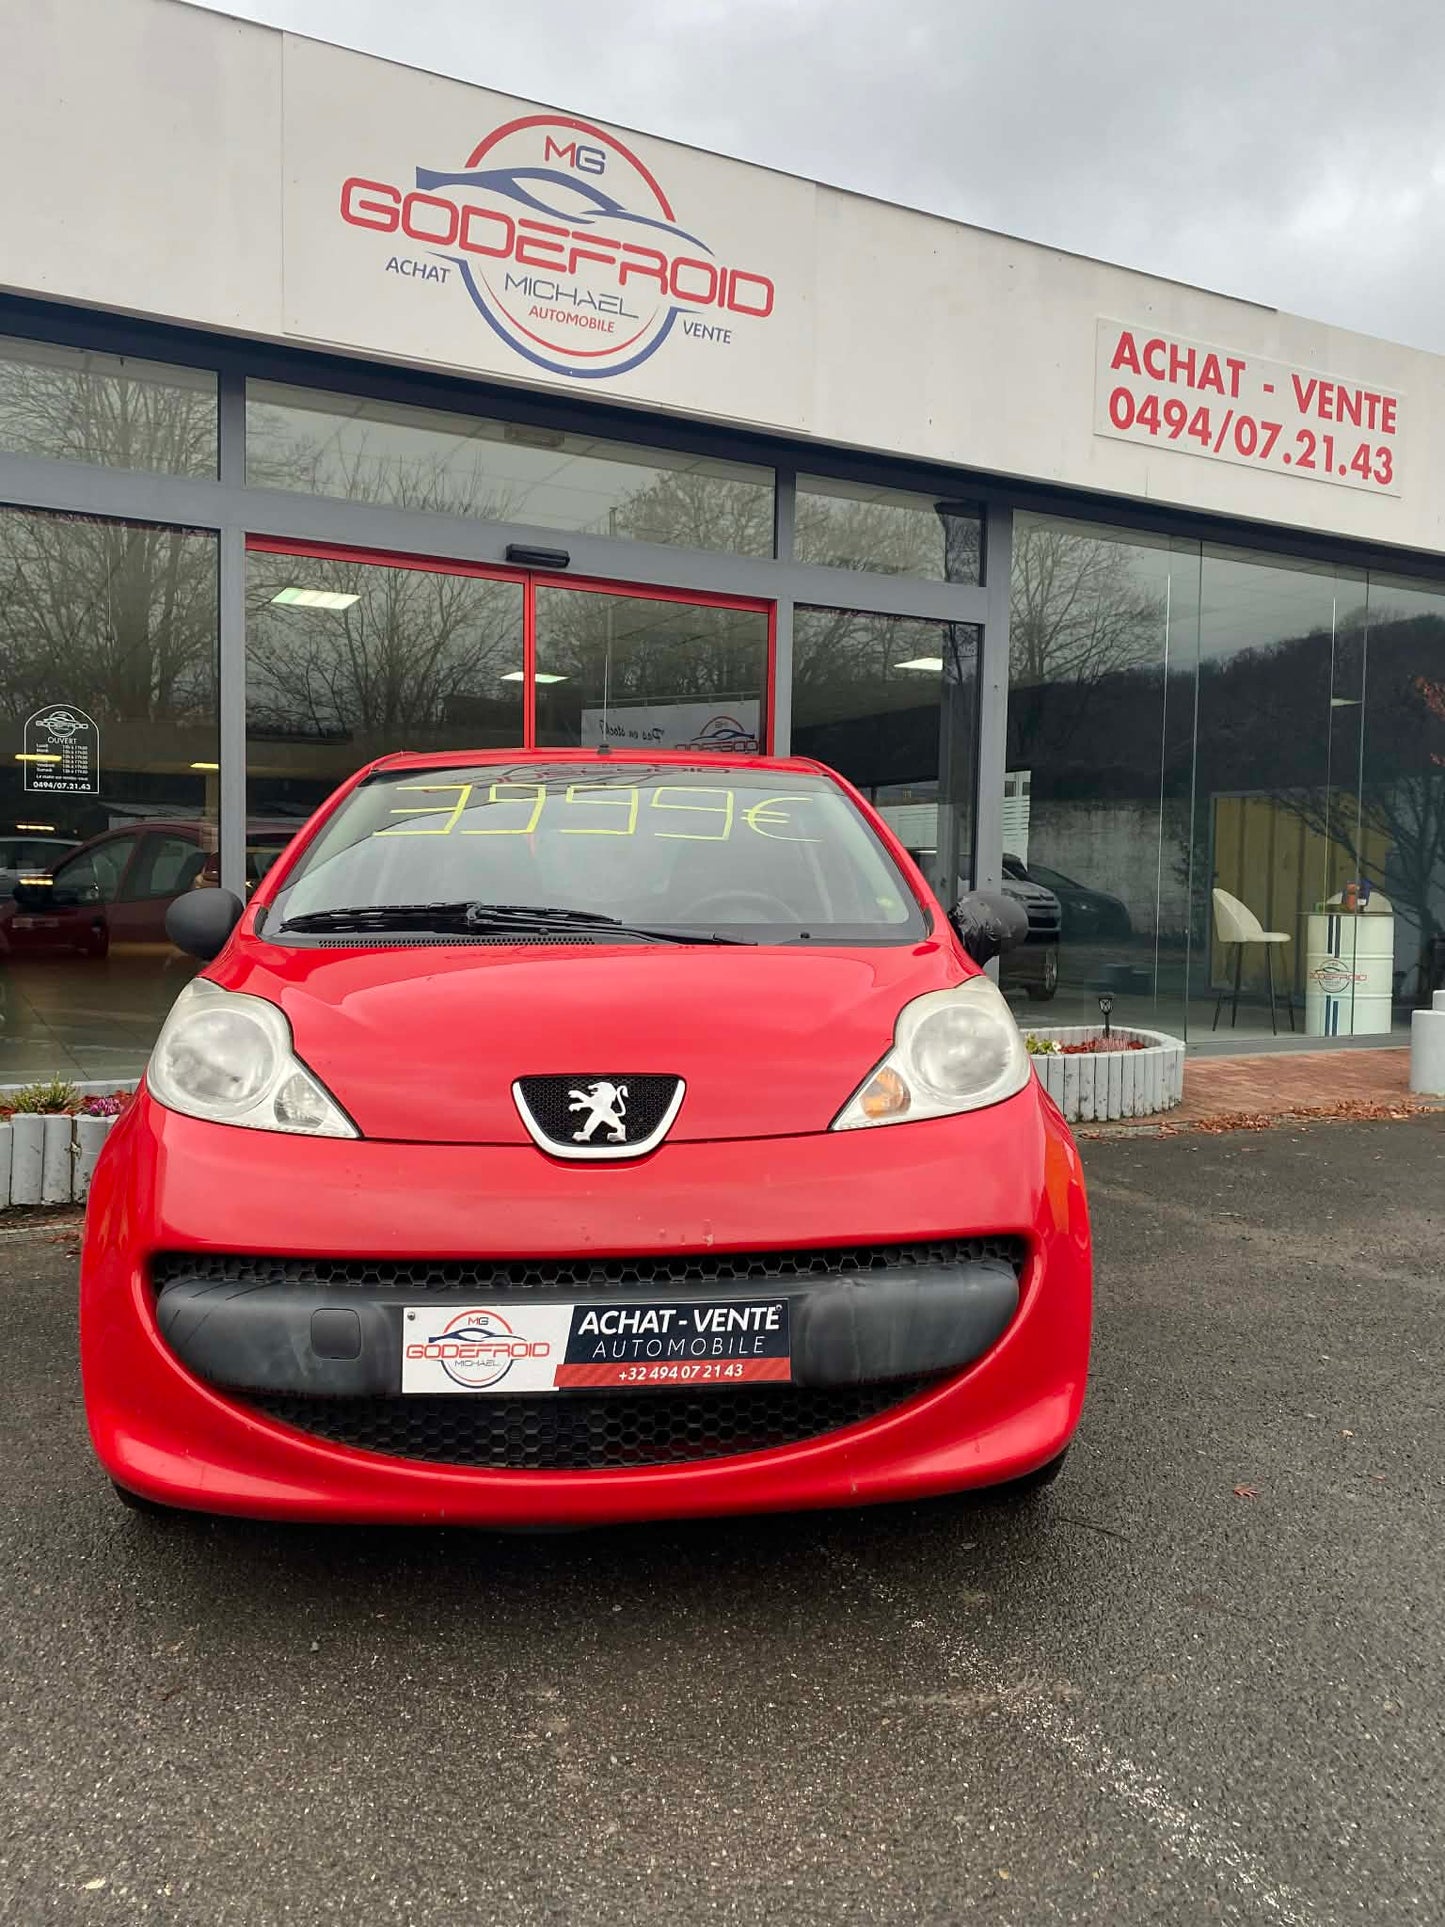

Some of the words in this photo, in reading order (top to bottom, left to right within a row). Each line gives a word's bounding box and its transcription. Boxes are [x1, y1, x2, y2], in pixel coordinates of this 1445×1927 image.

[544, 135, 606, 175] MG
[340, 177, 775, 318] GODEFROID
[385, 256, 451, 284] ACHAT
[504, 272, 640, 319] MICHAEL
[528, 304, 615, 334] AUTOMOBILE
[682, 319, 732, 345] VENTE
[1110, 330, 1247, 399] ACHAT
[1291, 373, 1397, 435] VENTE
[1109, 386, 1393, 486] 0494/07.21.43
[33, 780, 91, 790] 0494/07.21.43
[467, 1317, 489, 1326] MG
[406, 1342, 550, 1359] GODEFROID
[592, 1336, 767, 1359] AUTOMOBILE
[618, 1367, 647, 1381] +32
[648, 1366, 678, 1380] 494
[680, 1365, 701, 1379] 07
[703, 1364, 721, 1378] 21
[724, 1363, 744, 1377] 43
